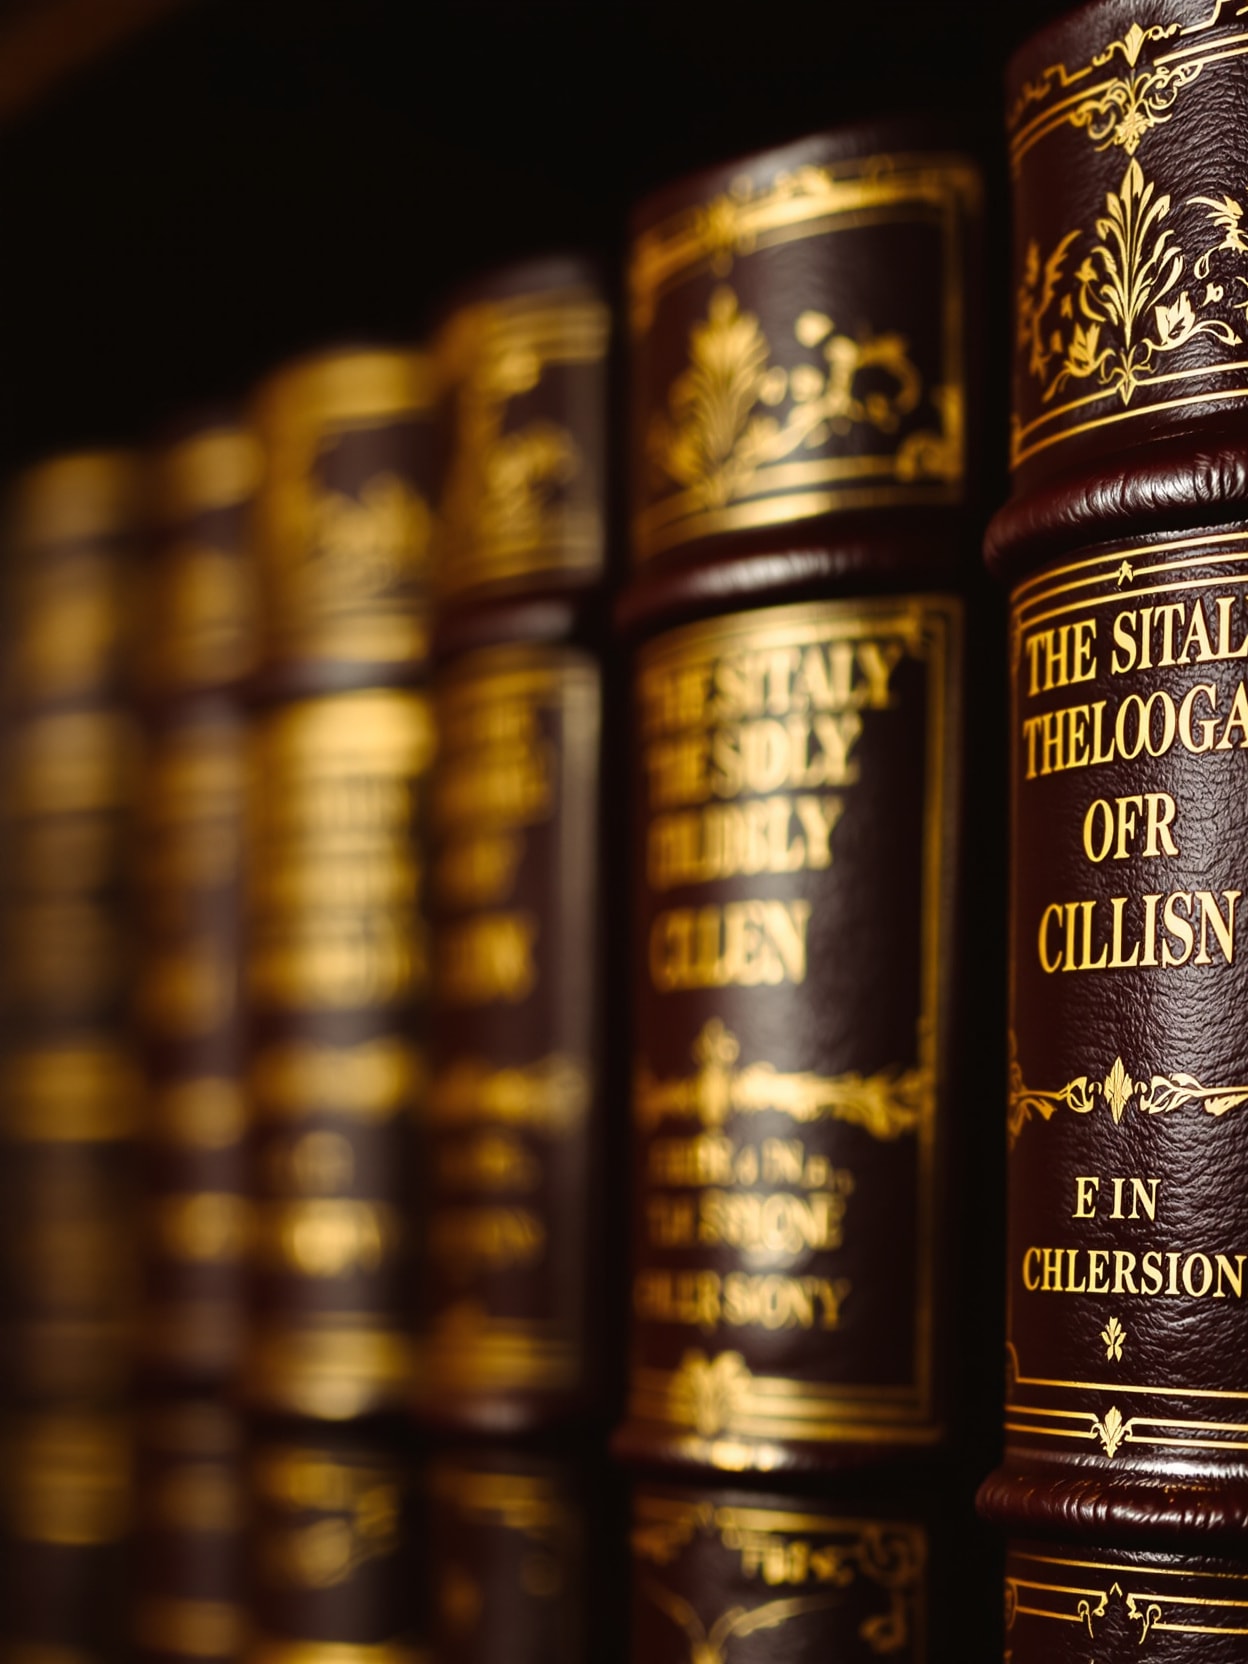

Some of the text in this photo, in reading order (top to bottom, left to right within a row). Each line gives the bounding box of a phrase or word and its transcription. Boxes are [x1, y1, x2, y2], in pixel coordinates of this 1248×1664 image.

[1026, 618, 1097, 697] THE
[1083, 792, 1180, 863] OFR
[1037, 889, 1242, 973] CILLISN
[1072, 1176, 1161, 1222] E IN
